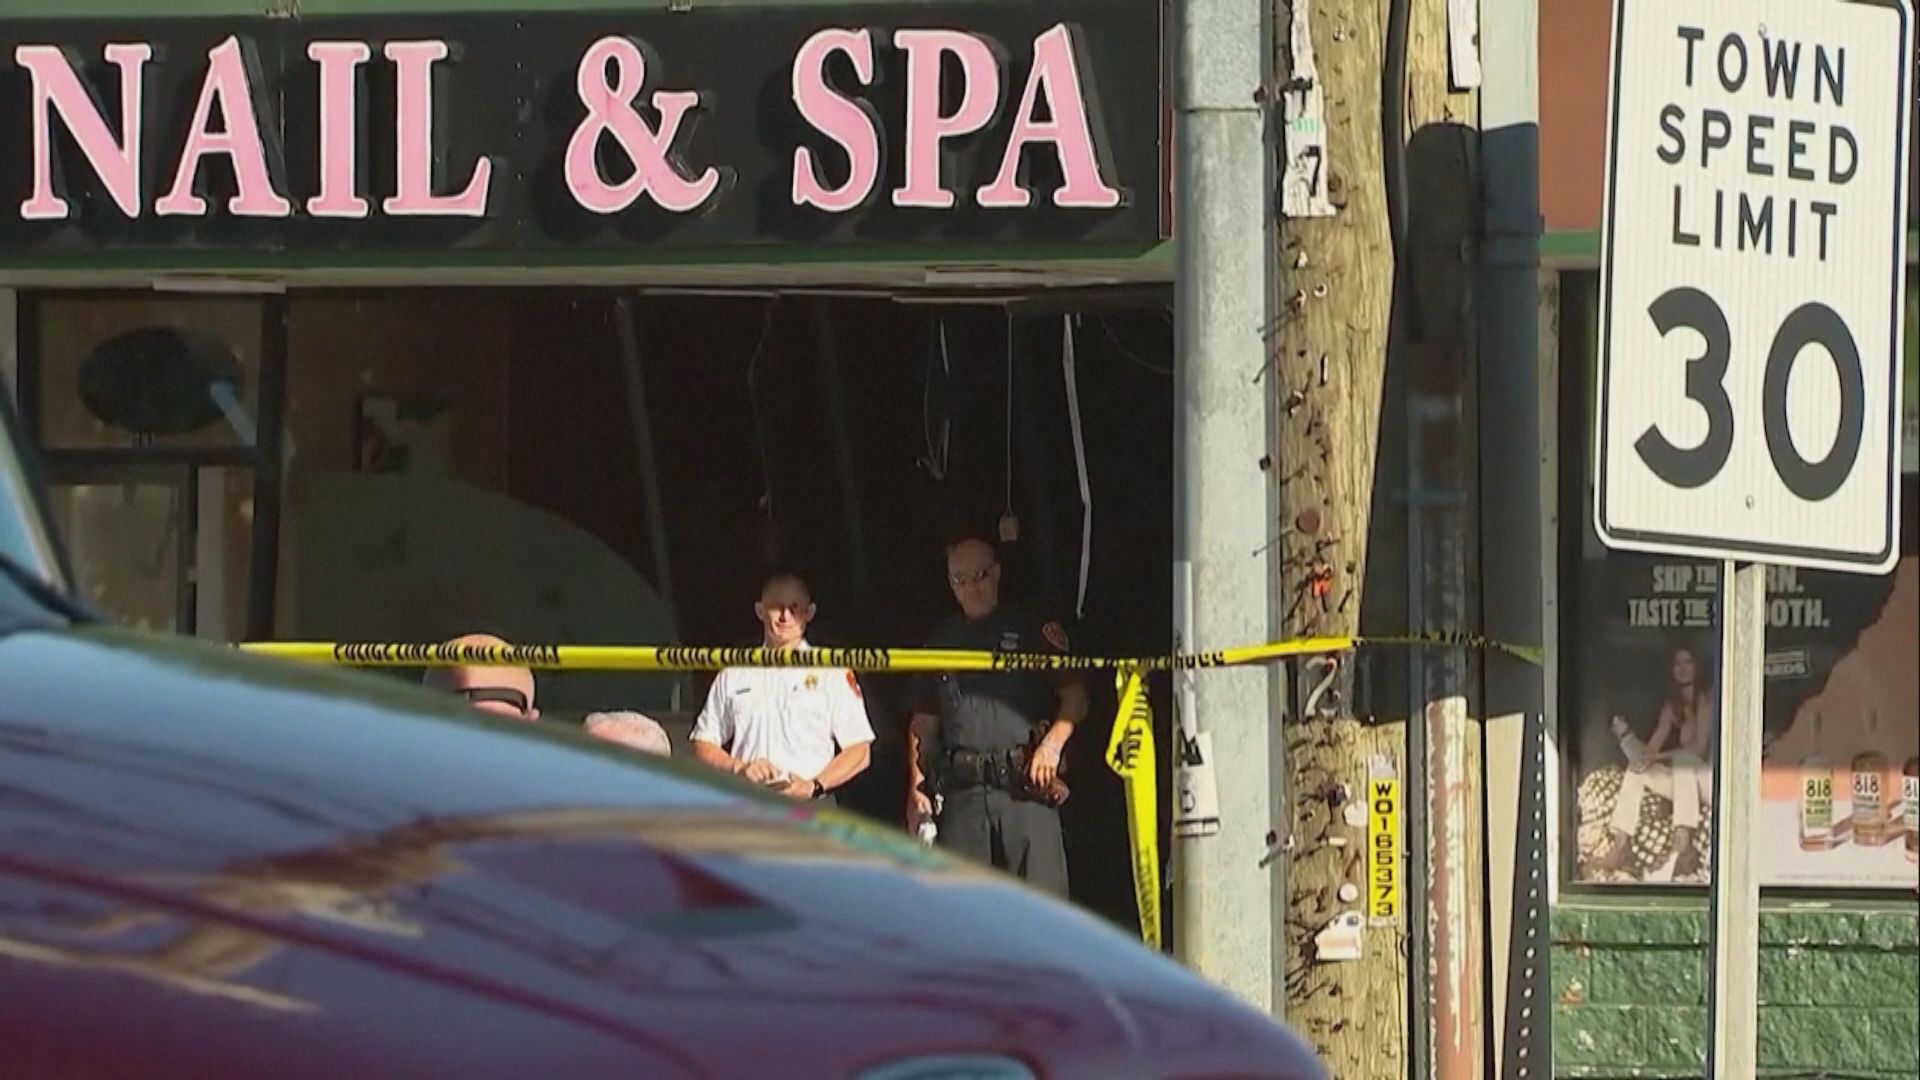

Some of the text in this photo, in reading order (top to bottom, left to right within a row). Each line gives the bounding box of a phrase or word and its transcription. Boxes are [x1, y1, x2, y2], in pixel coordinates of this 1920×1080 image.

[1677, 25, 1845, 107] TOWN
[16, 22, 1120, 219] NAIL & SPA
[1656, 103, 1859, 185] SPEED
[1672, 184, 1838, 261] LIMIT
[1633, 286, 1865, 502] 30
[1652, 565, 1693, 592] SKIP
[1628, 598, 1680, 627] TASTE
[1683, 599, 1710, 622] THE
[1805, 778, 1832, 798] 818
[1855, 773, 1880, 794] 818
[1903, 779, 1919, 798] 81
